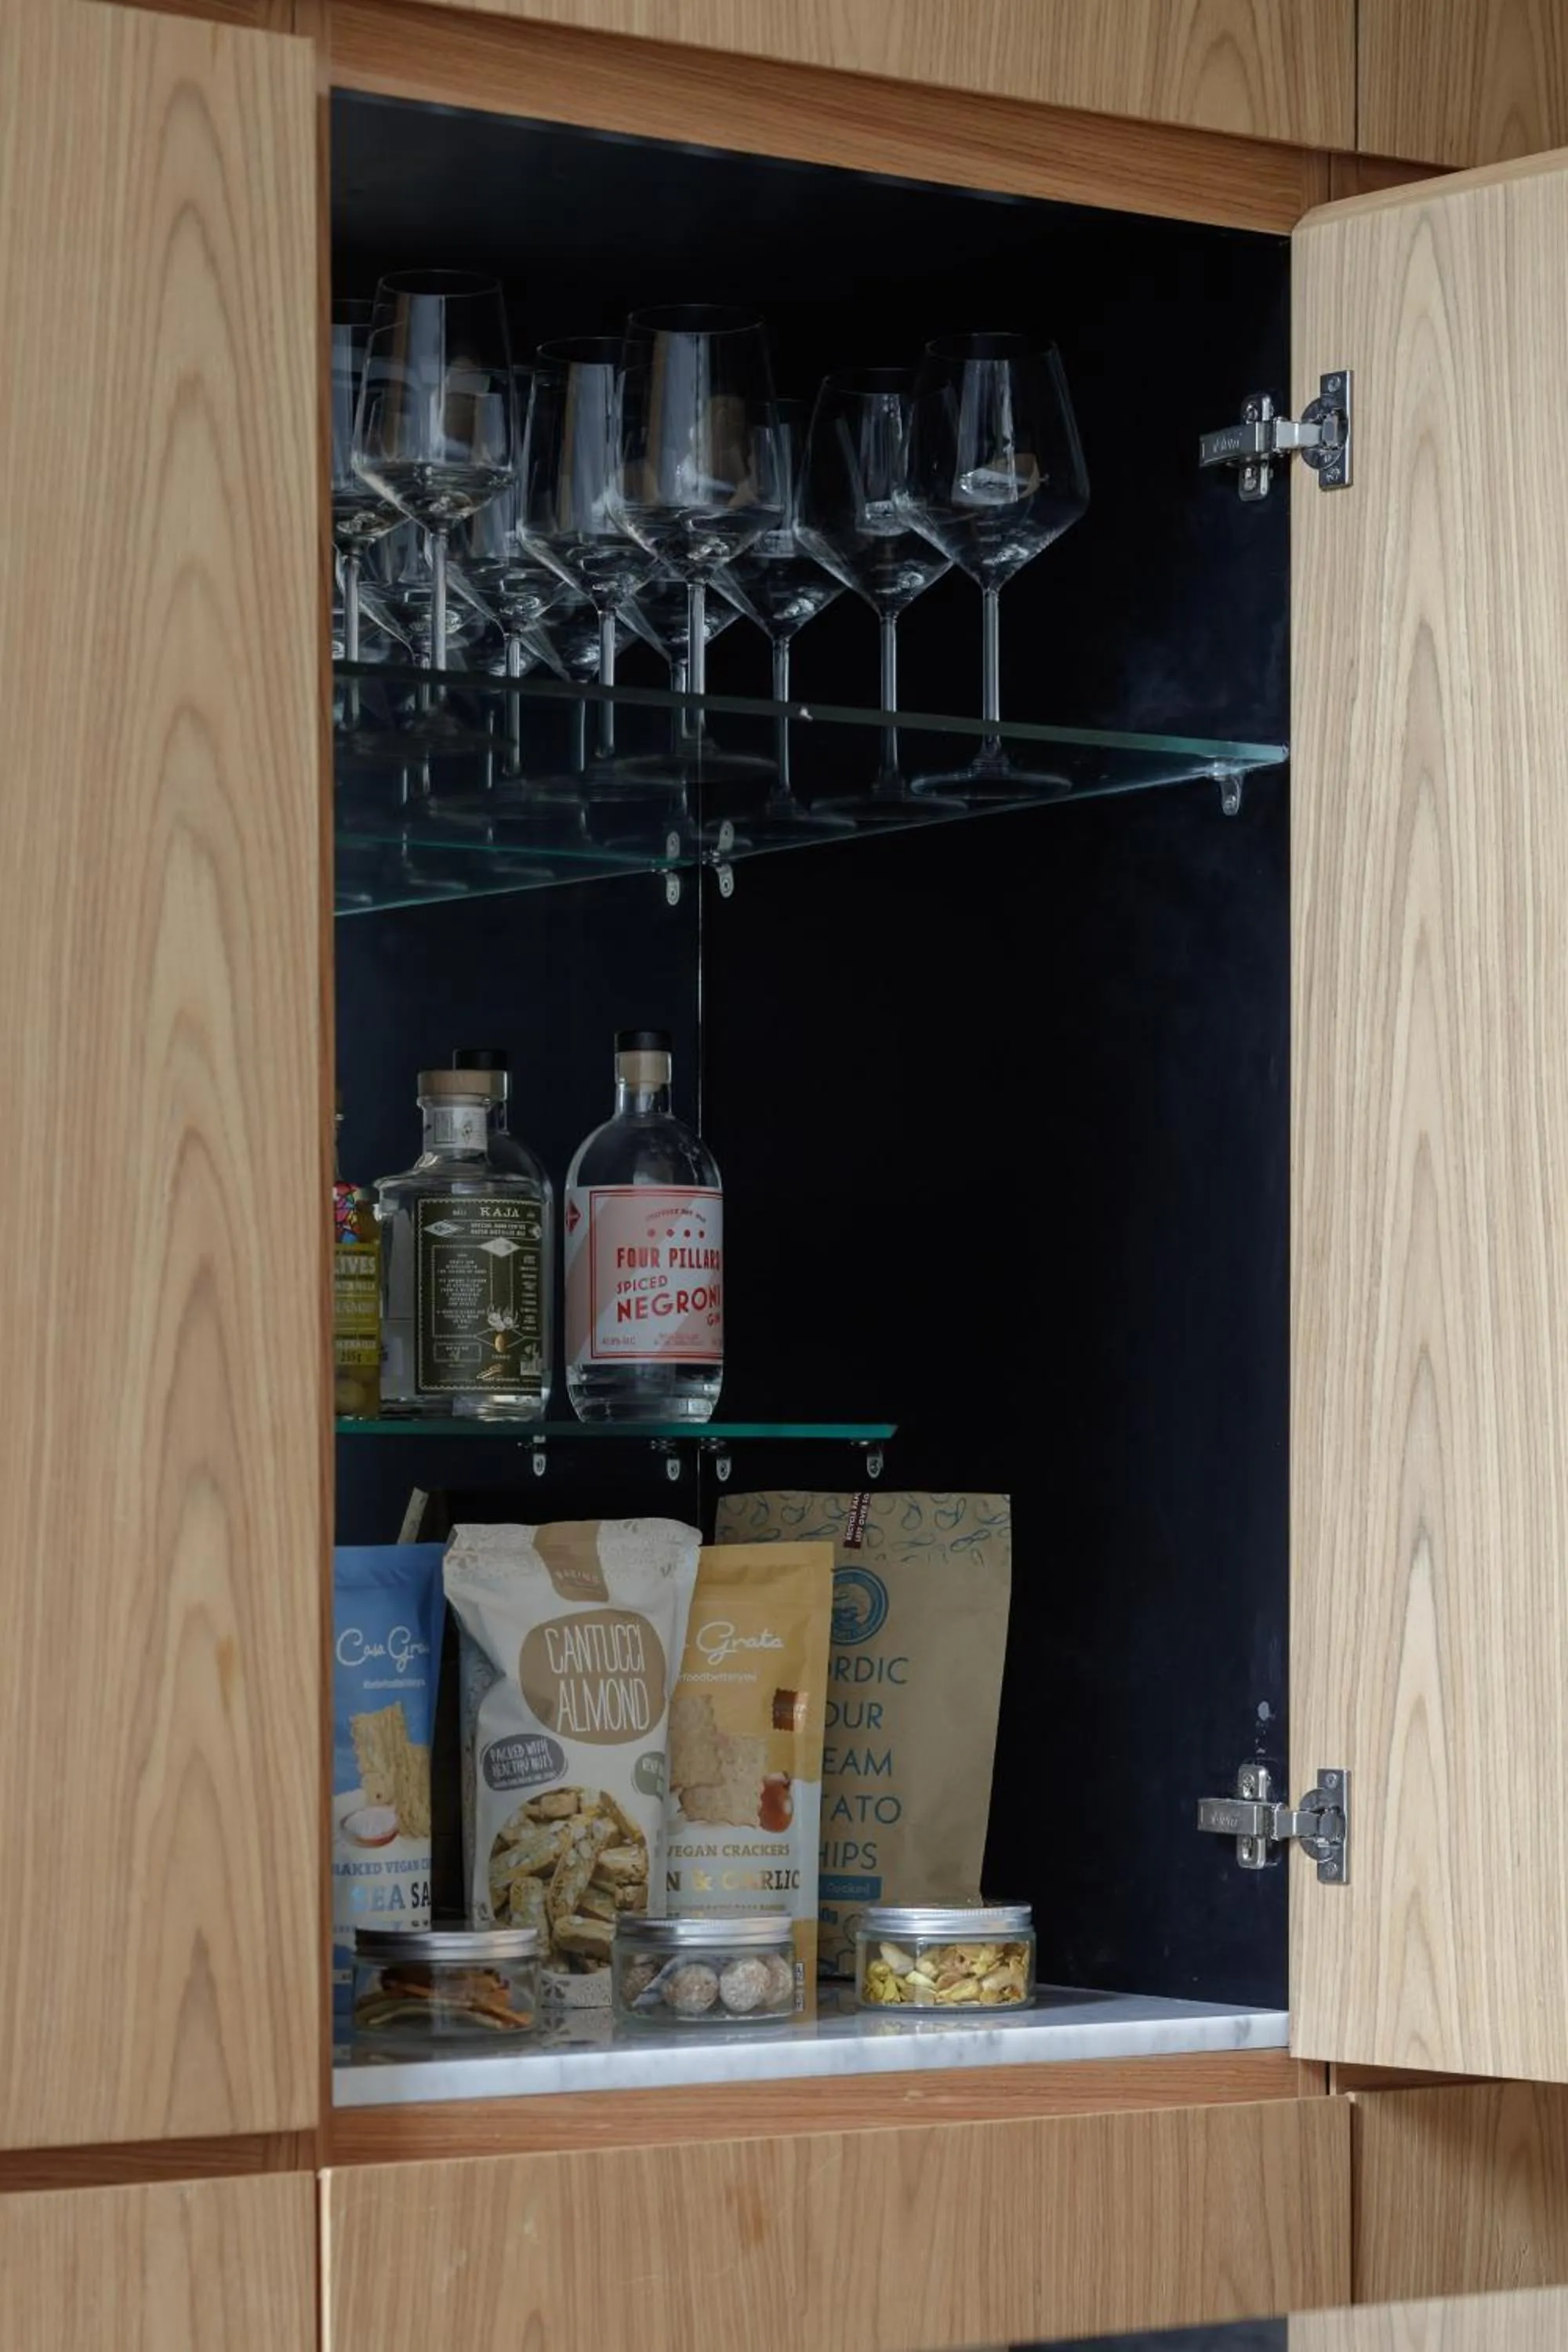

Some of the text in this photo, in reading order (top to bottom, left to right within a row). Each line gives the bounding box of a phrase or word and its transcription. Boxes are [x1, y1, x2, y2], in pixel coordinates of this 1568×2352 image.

[479, 1207, 520, 1218] KAJA
[336, 1256, 376, 1275] IVES
[616, 1247, 661, 1269] FOUR
[616, 1275, 668, 1294] SPICED
[617, 1284, 720, 1323] NEGRONI
[544, 1624, 645, 1675] CANTUCCI
[829, 1656, 909, 1685] RDIC
[557, 1678, 651, 1732] ALMOND
[722, 1843, 789, 1857] CRACKERS
